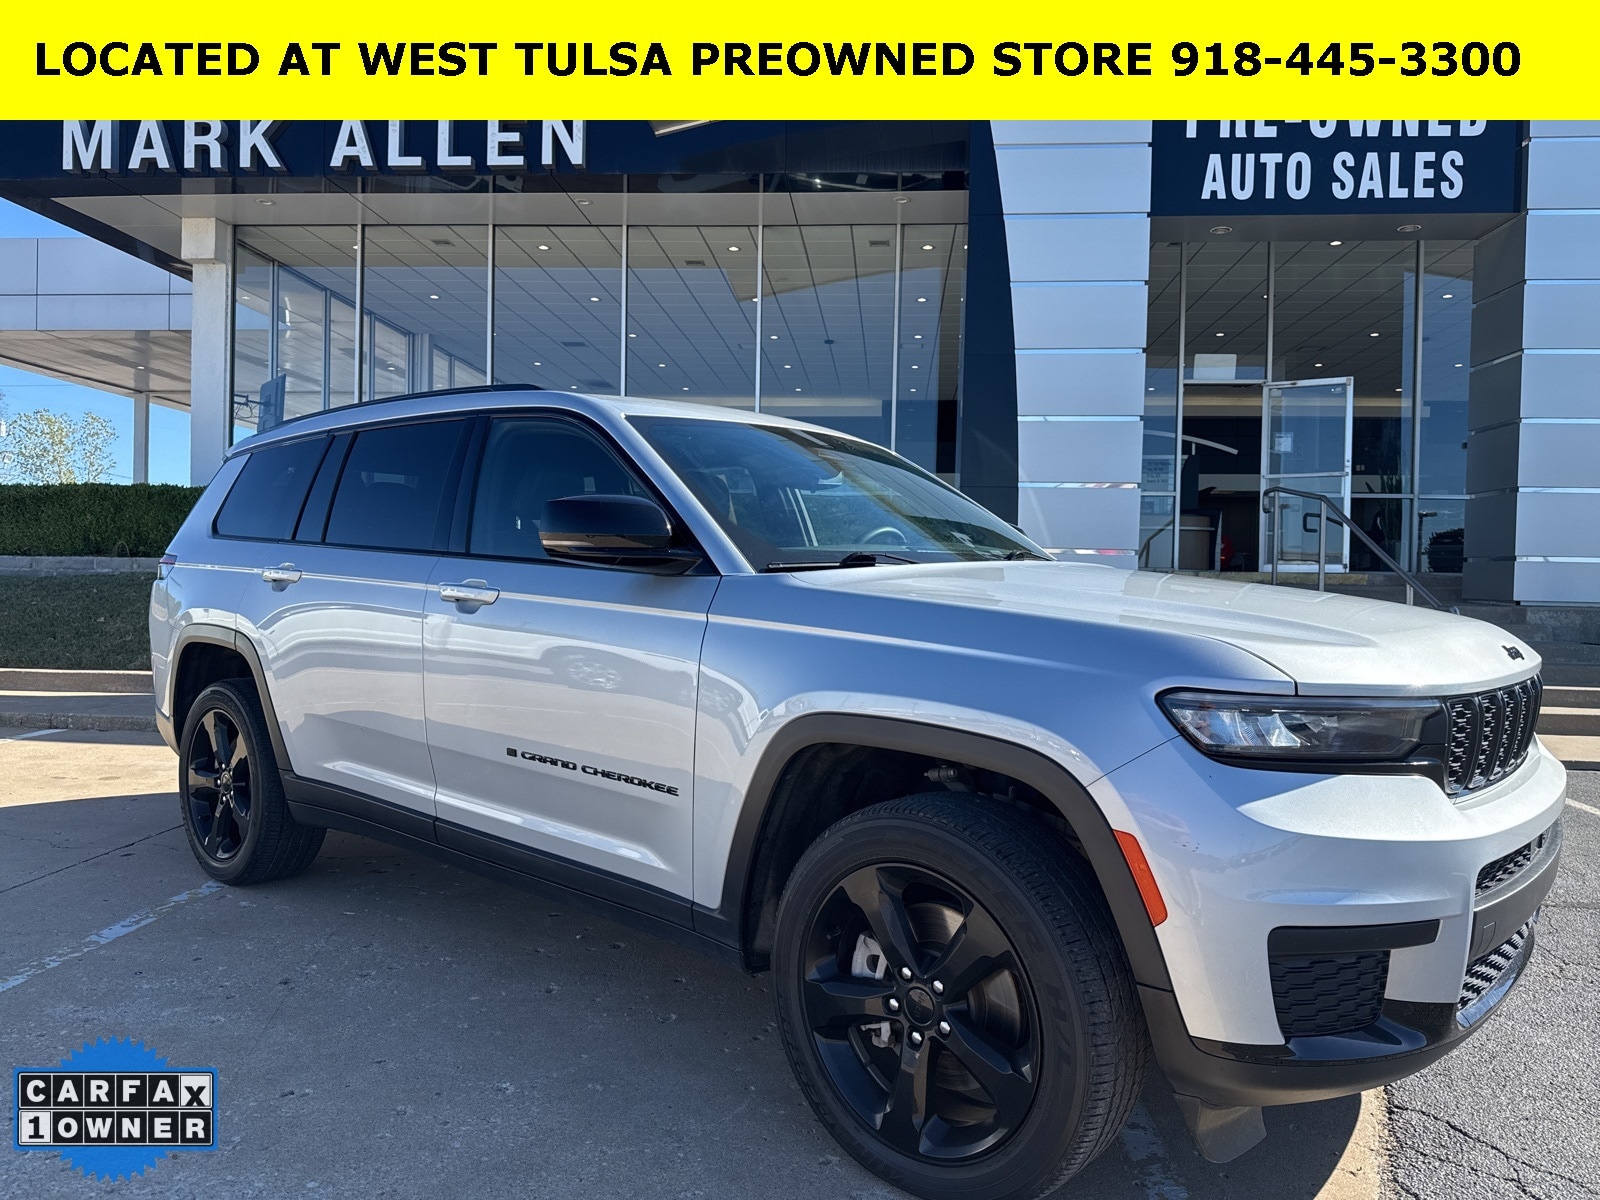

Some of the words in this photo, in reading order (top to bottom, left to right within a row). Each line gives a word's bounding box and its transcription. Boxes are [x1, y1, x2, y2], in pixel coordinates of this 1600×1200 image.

[62, 120, 284, 170] MARK
[329, 120, 586, 168] ALLEN
[1200, 151, 1312, 201] AUTO
[1331, 150, 1464, 200] SALES
[520, 751, 578, 771] GRAND
[580, 764, 680, 797] CHEROKEE
